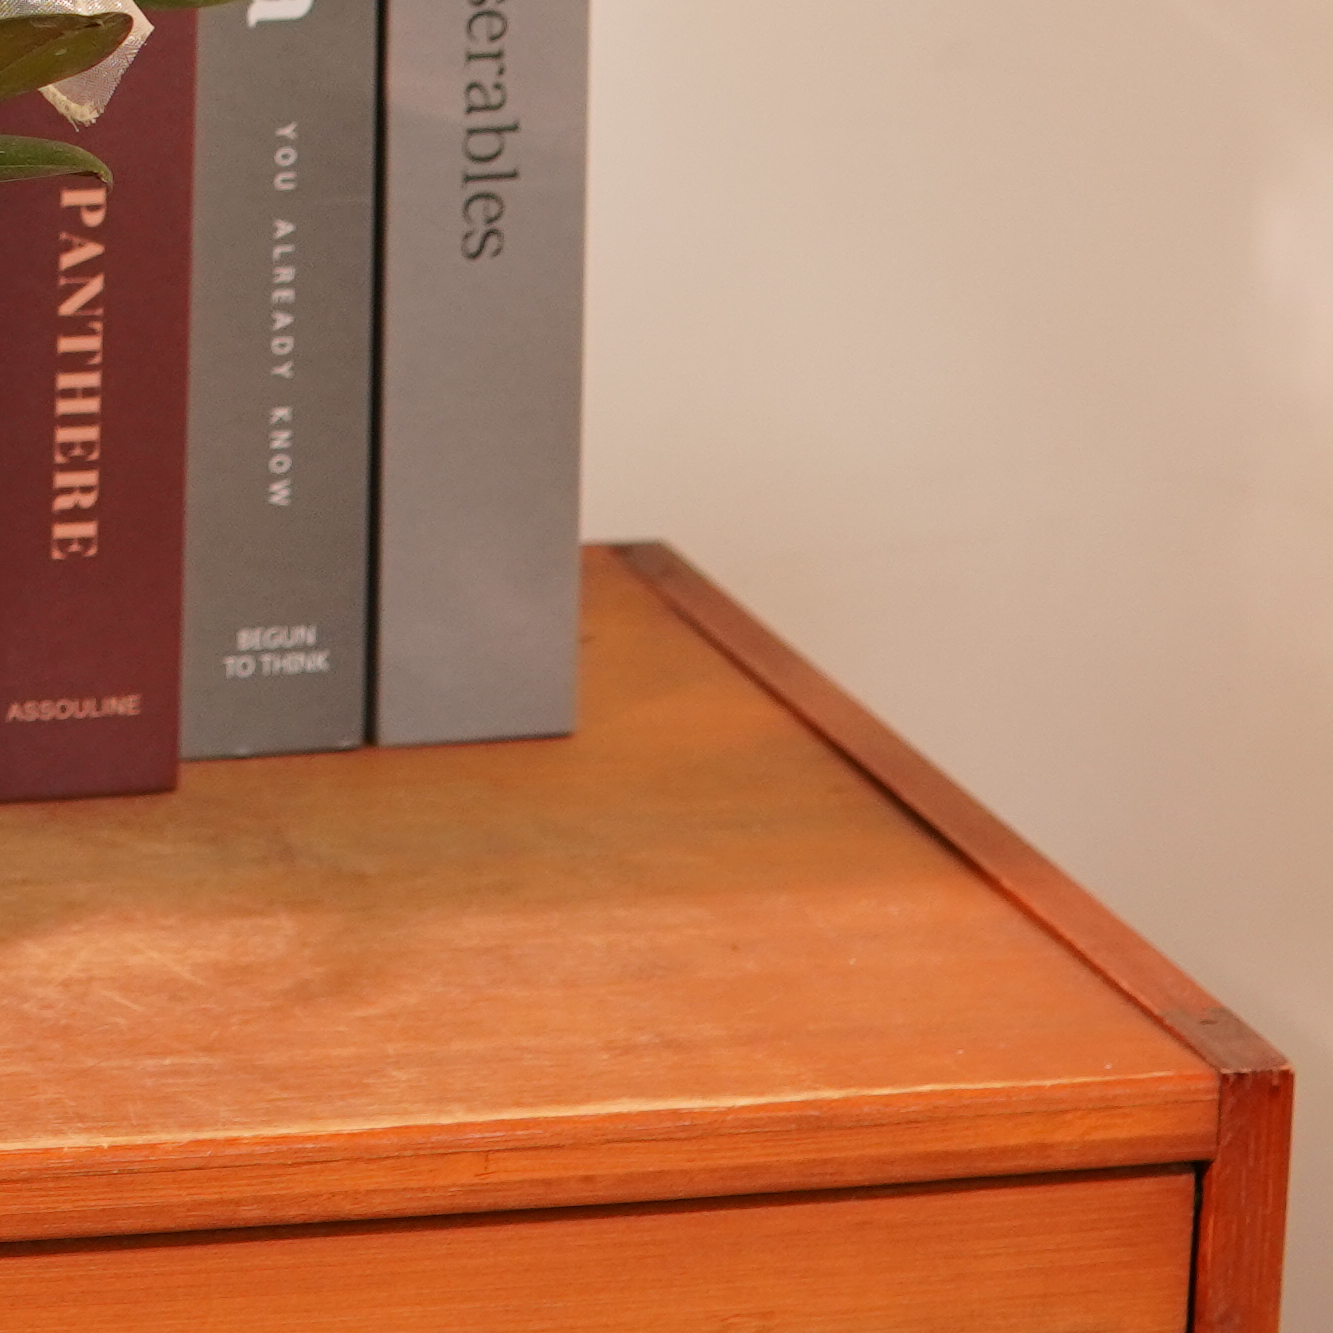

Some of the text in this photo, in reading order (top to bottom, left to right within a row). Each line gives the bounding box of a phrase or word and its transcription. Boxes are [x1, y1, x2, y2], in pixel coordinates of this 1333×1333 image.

[268, 122, 298, 507] YOU ALREADY KNOW
[50, 185, 107, 560] PANTHERE
[236, 625, 317, 651] BEGUN
[223, 650, 331, 679] TO THINK
[5, 694, 143, 723] ASSOULINE
